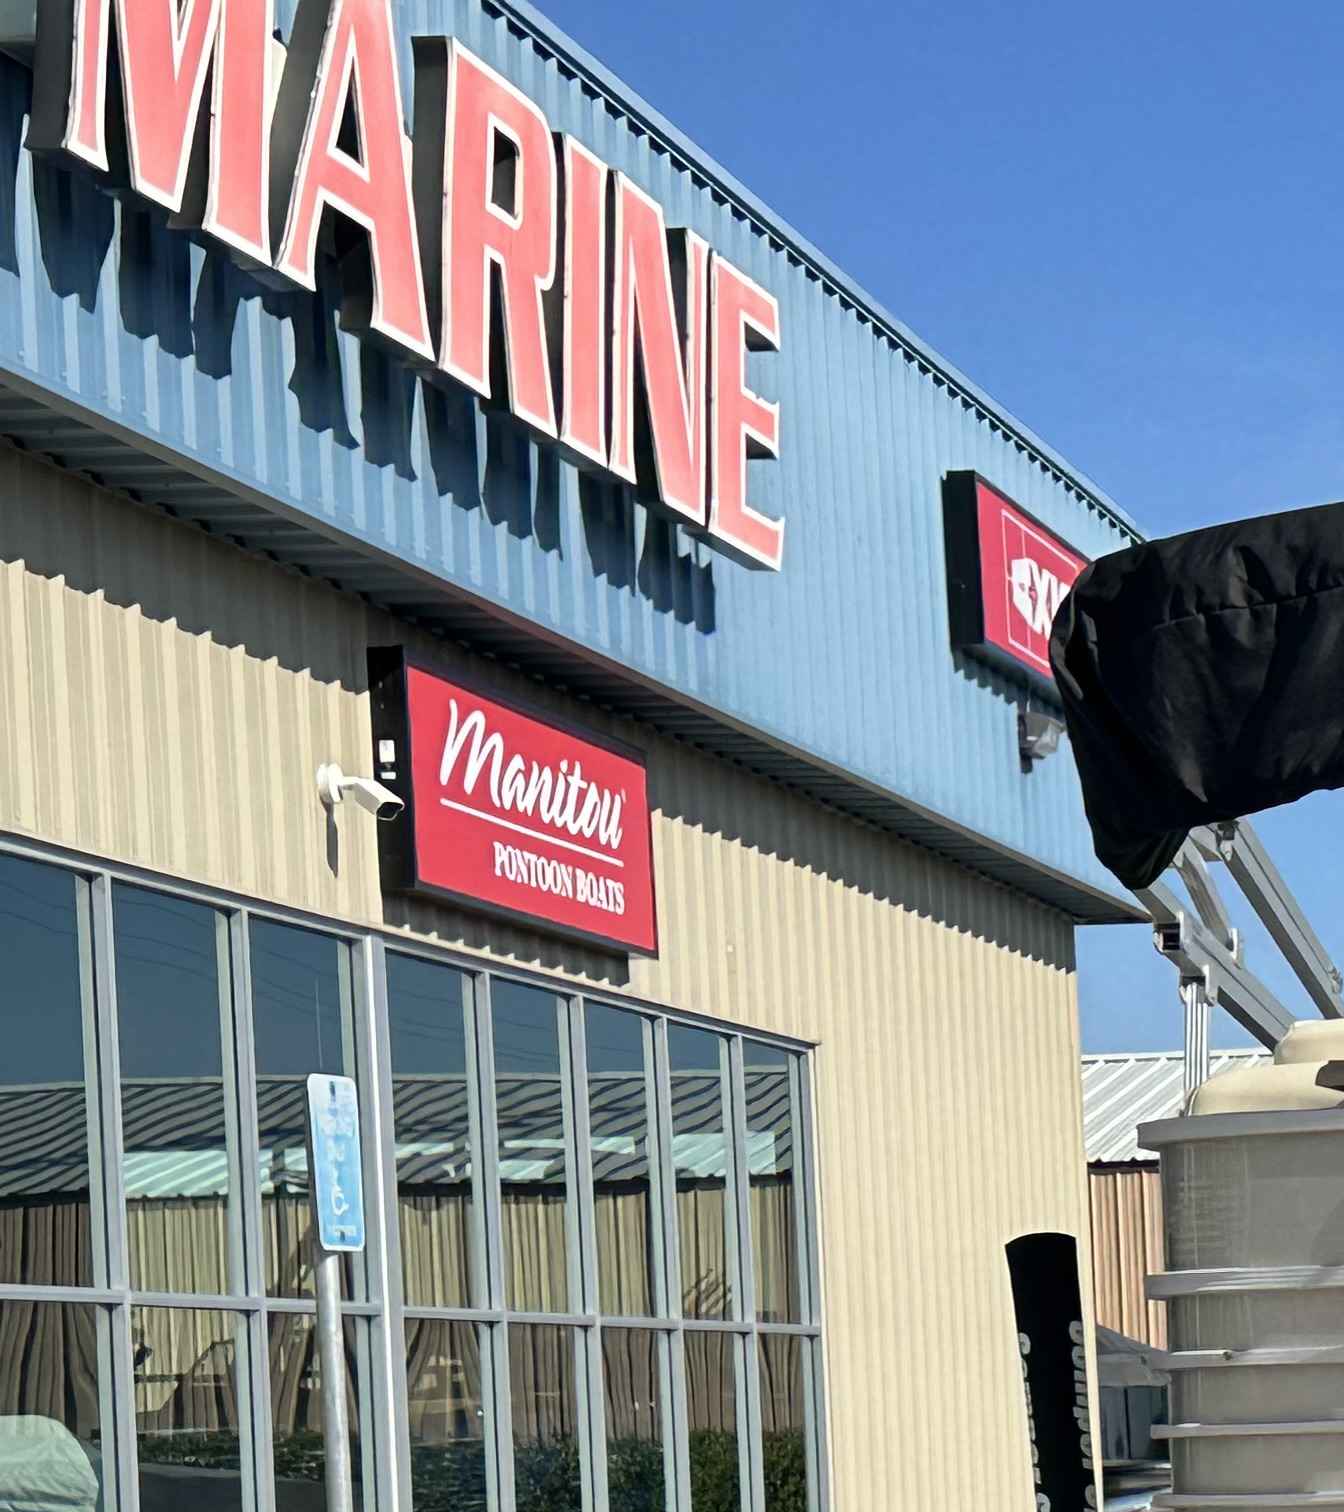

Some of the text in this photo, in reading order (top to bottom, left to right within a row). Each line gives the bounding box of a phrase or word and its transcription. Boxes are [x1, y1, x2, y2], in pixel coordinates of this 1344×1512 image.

[62, 0, 785, 572] MARINE
[438, 698, 625, 850] Manitou
[493, 840, 625, 916] PONTOON BOATS
